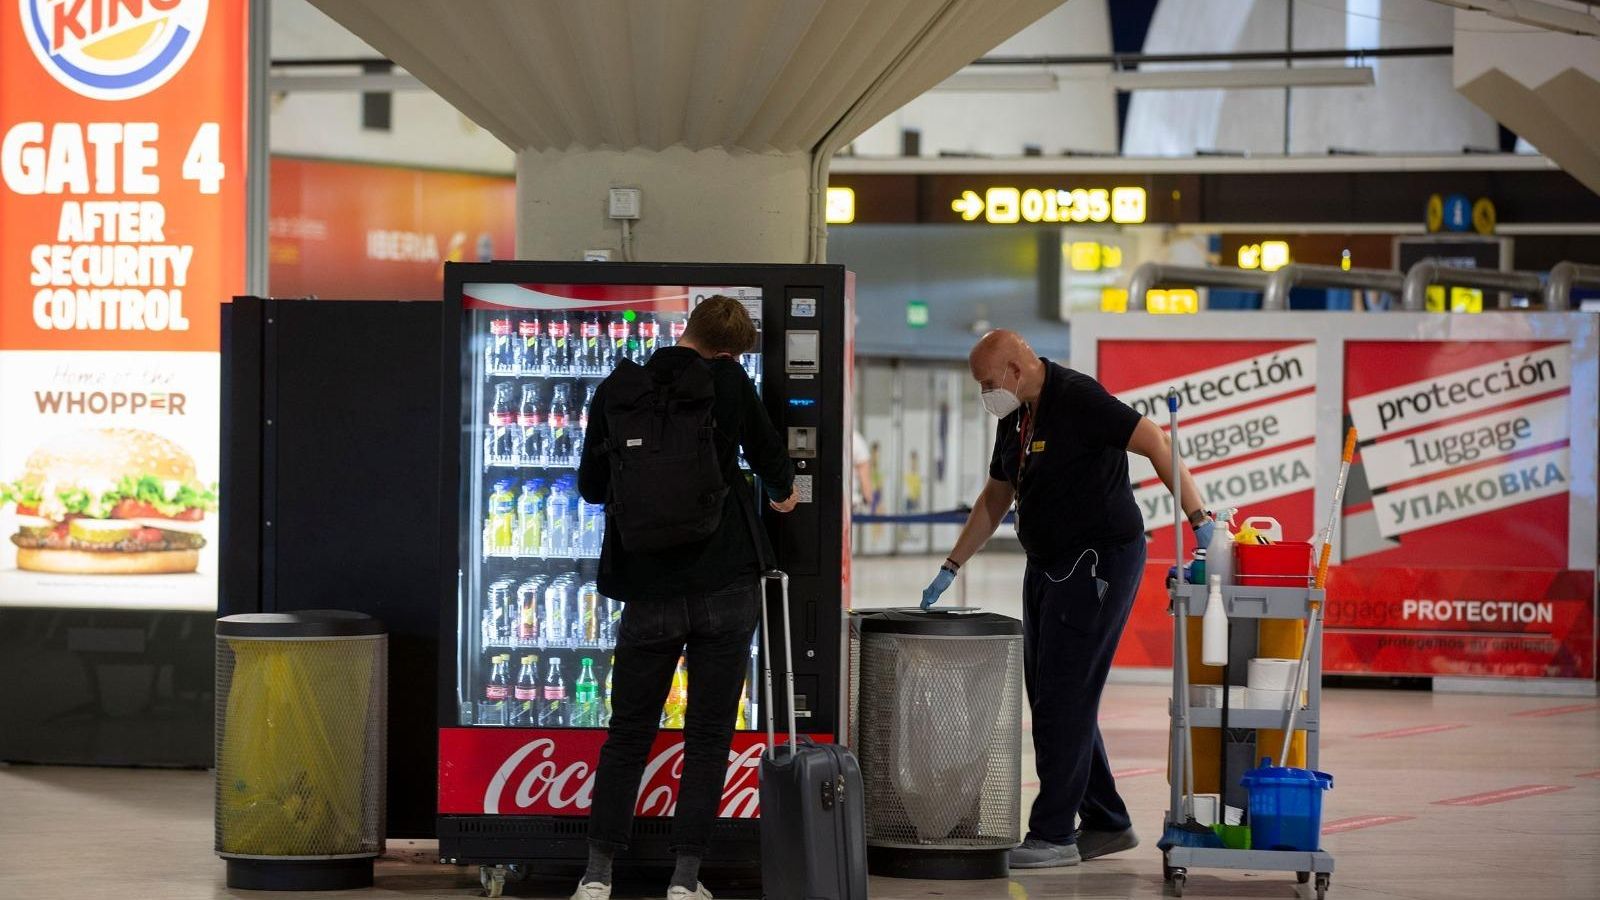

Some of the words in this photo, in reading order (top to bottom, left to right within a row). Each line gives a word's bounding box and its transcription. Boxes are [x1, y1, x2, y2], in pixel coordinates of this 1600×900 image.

[53, 0, 183, 50] KIN
[1, 122, 159, 194] GATE
[182, 123, 225, 194] 4
[57, 201, 165, 243] AFTER
[30, 245, 193, 287] SECURITY
[366, 229, 440, 263] IBERIA
[32, 289, 189, 331] CONTROL
[34, 391, 187, 415] WHOPPER
[1377, 355, 1557, 430] protección
[1178, 414, 1279, 462] uggage
[1405, 416, 1532, 468] luggage
[1390, 462, 1566, 524] УПАКОВКА
[1403, 600, 1553, 623] PROTECTION
